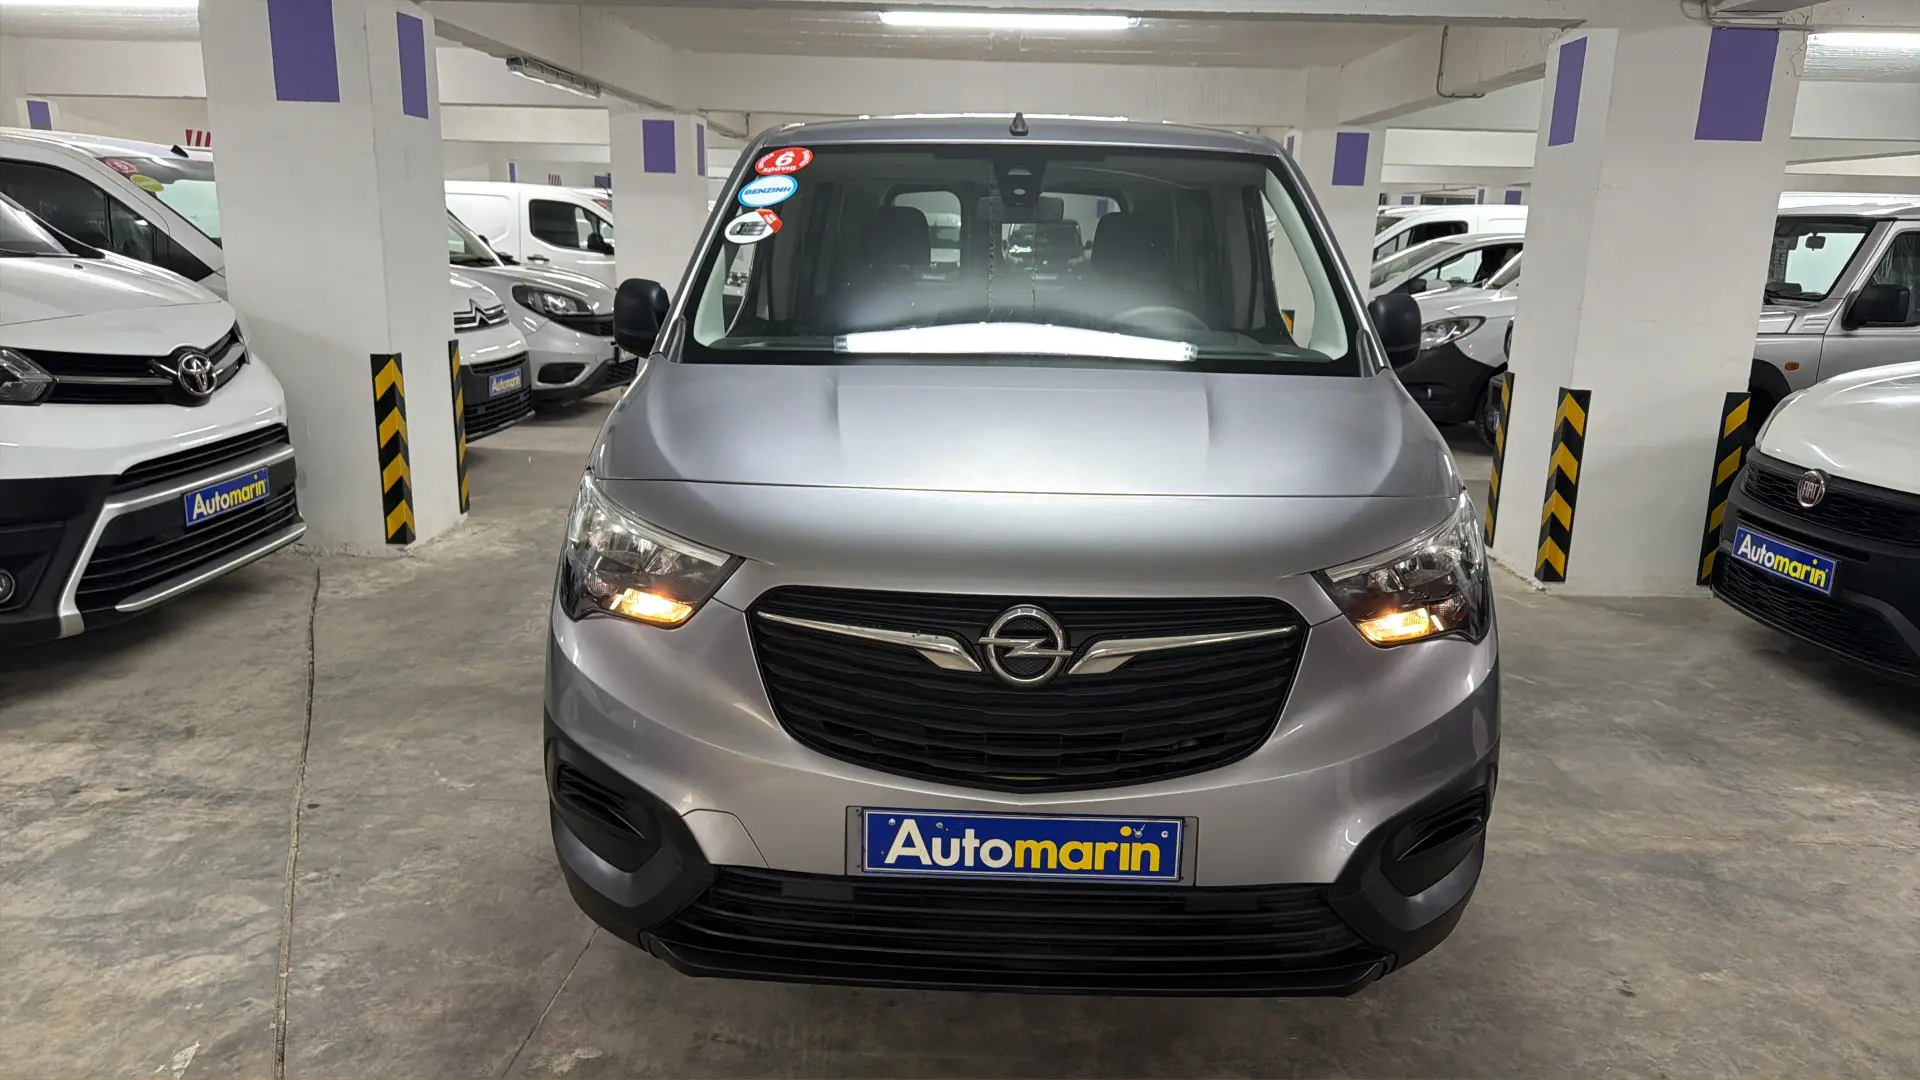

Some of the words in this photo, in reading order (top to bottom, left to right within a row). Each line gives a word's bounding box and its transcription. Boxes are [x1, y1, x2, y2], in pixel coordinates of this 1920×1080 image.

[775, 151, 795, 166] 6
[192, 474, 266, 520] Automarin
[1802, 481, 1820, 500] FIAT
[1738, 534, 1826, 588] Automarin
[884, 819, 1160, 871] Automarin
